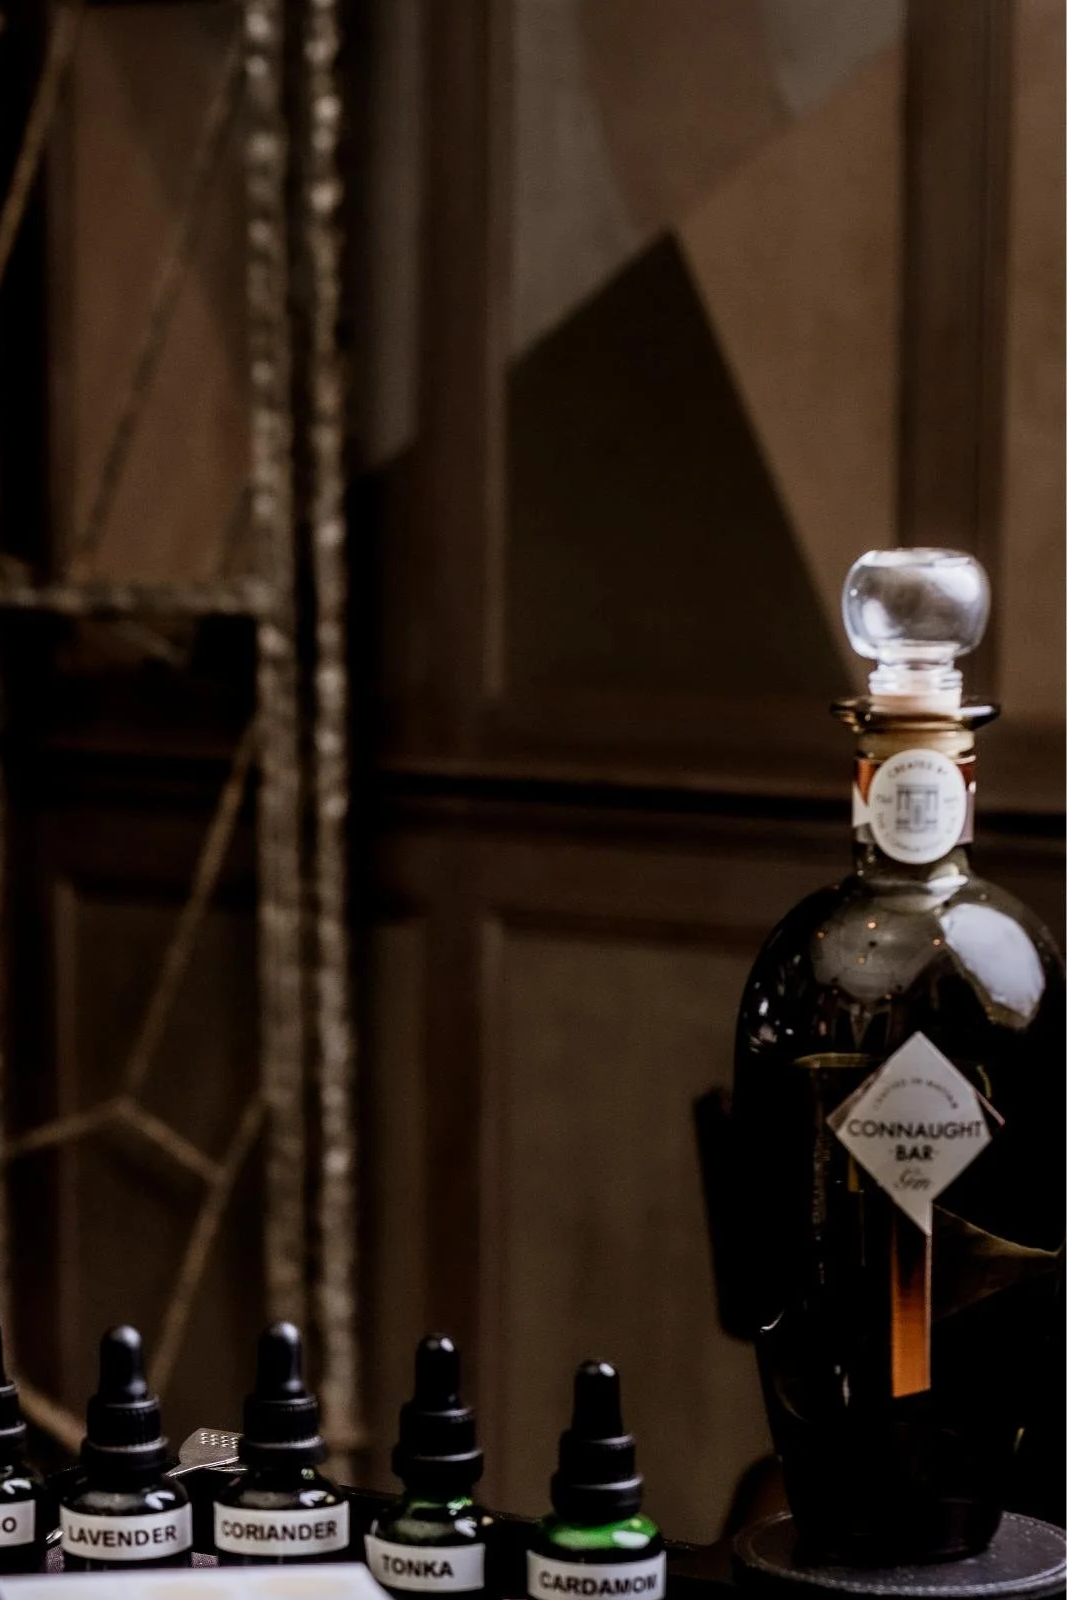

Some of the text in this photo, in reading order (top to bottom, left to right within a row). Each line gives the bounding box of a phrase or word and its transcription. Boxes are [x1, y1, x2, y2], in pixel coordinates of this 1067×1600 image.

[846, 1118, 983, 1139] CONNAUGHT
[895, 1144, 933, 1162] BAR
[68, 1524, 177, 1548] LAVENDER
[220, 1518, 338, 1542] CORIANDER
[381, 1554, 454, 1579] TONKA
